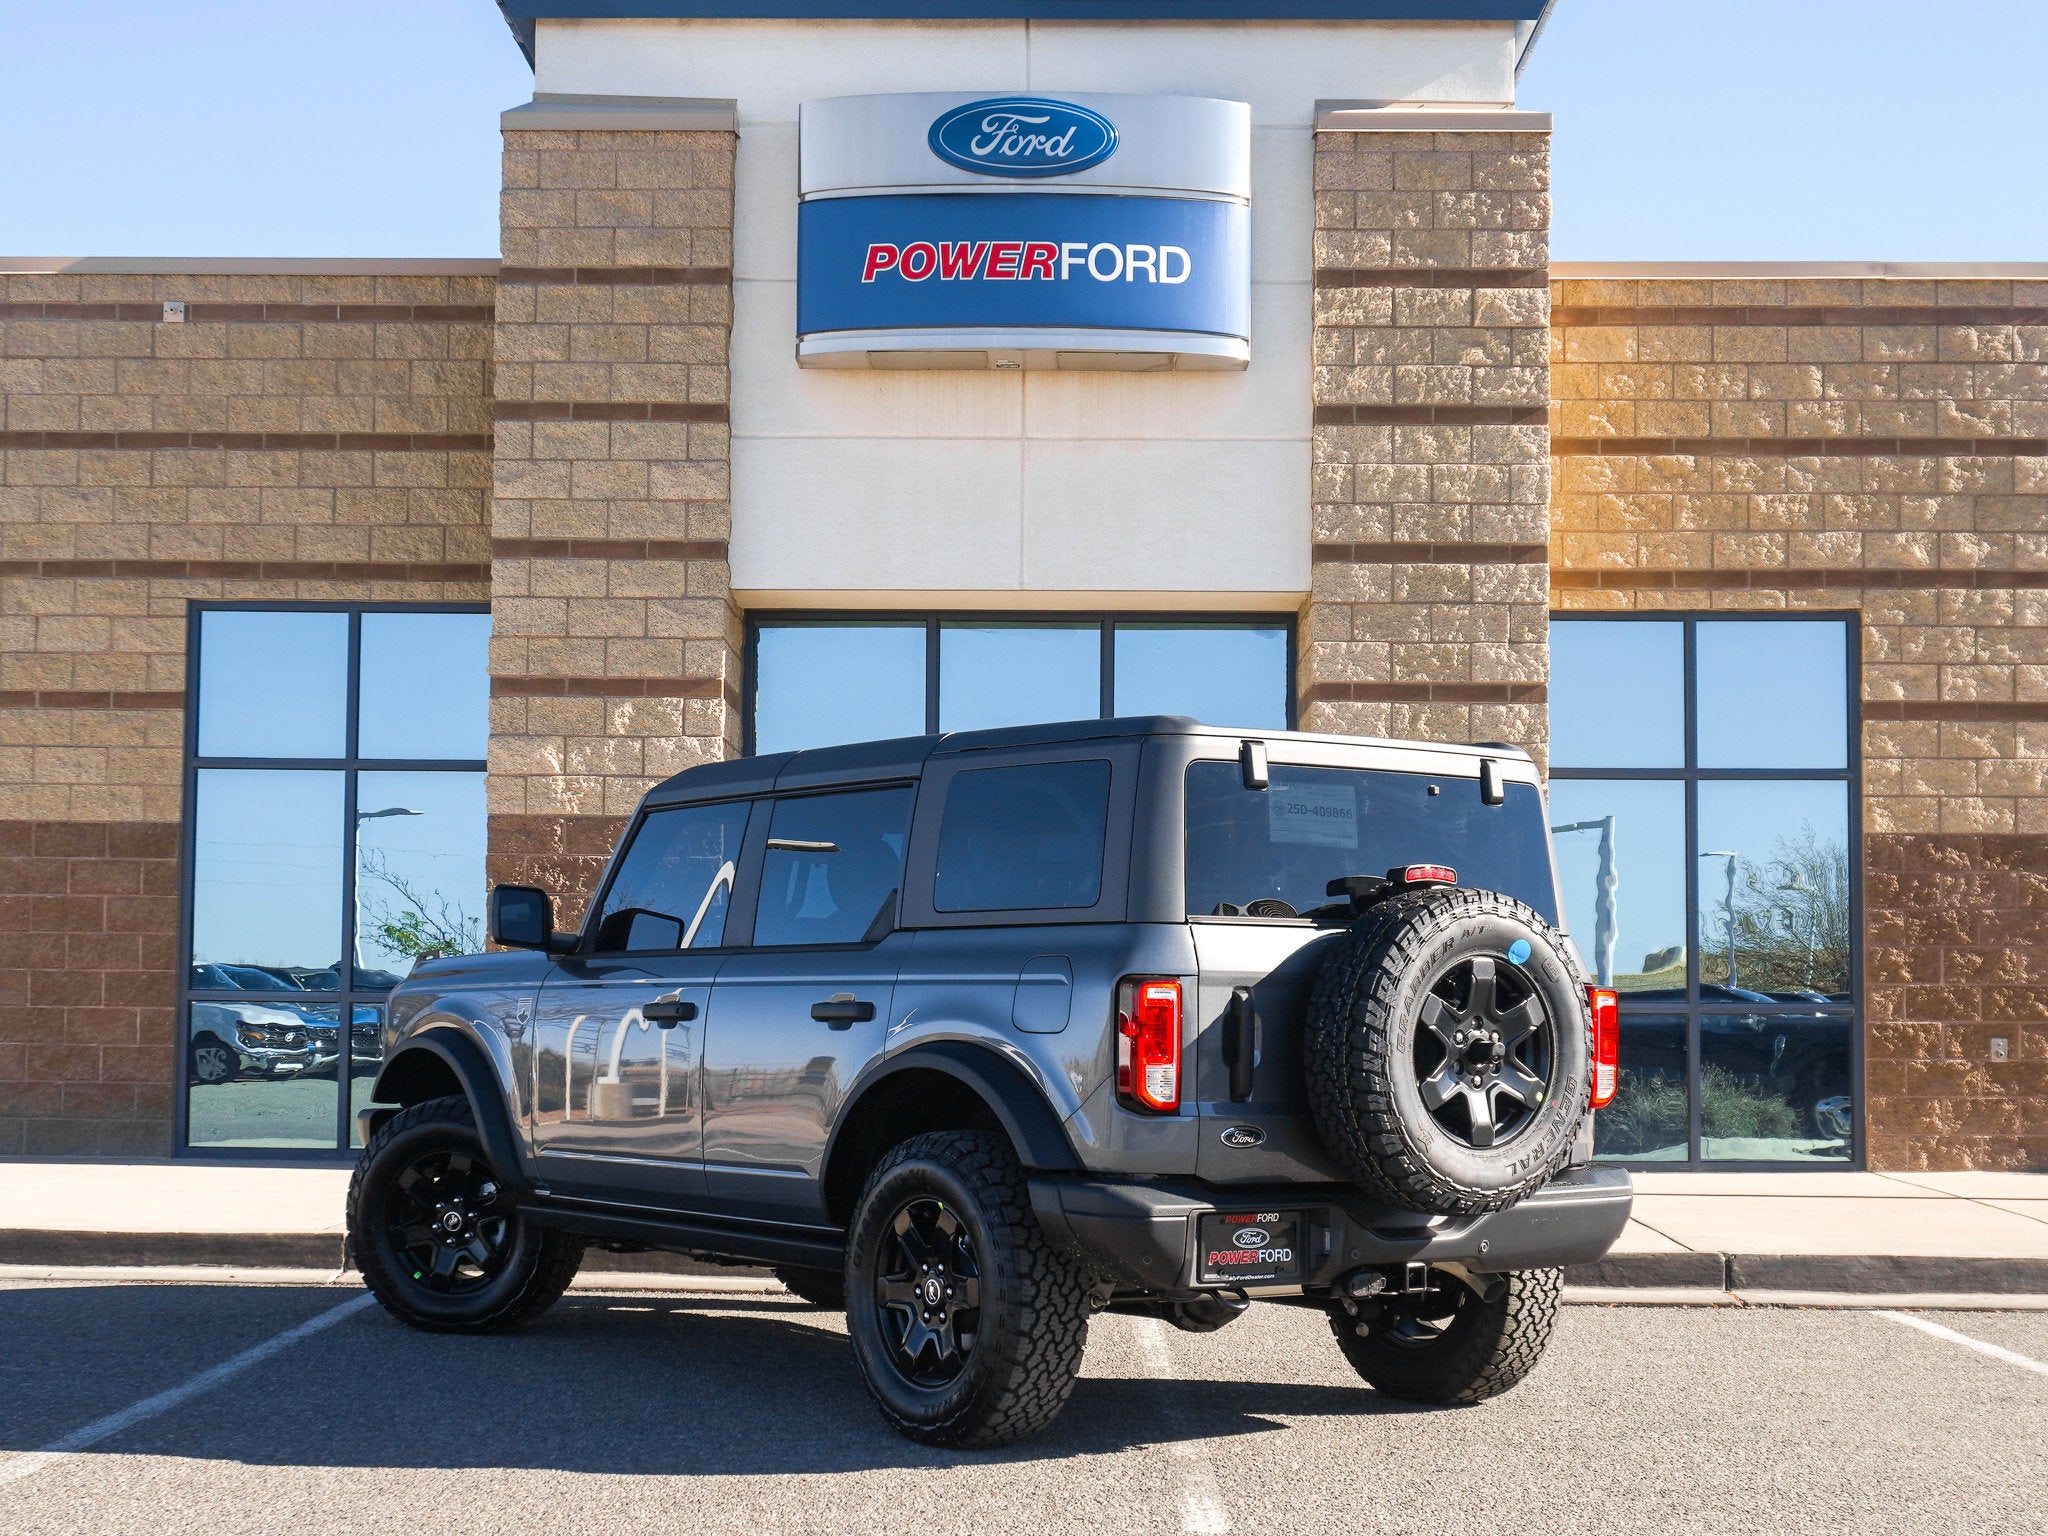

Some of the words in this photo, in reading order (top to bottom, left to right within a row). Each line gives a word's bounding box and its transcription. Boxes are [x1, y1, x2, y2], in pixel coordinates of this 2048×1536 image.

[970, 112, 1077, 159] Ford
[861, 241, 1192, 284] POWERFORD
[1504, 1076, 1577, 1177] GENERAL
[1232, 1130, 1255, 1143] Ford
[1224, 1213, 1280, 1224] POWERFORD
[1240, 1231, 1262, 1244] Ford
[1208, 1248, 1292, 1266] POWERFORD
